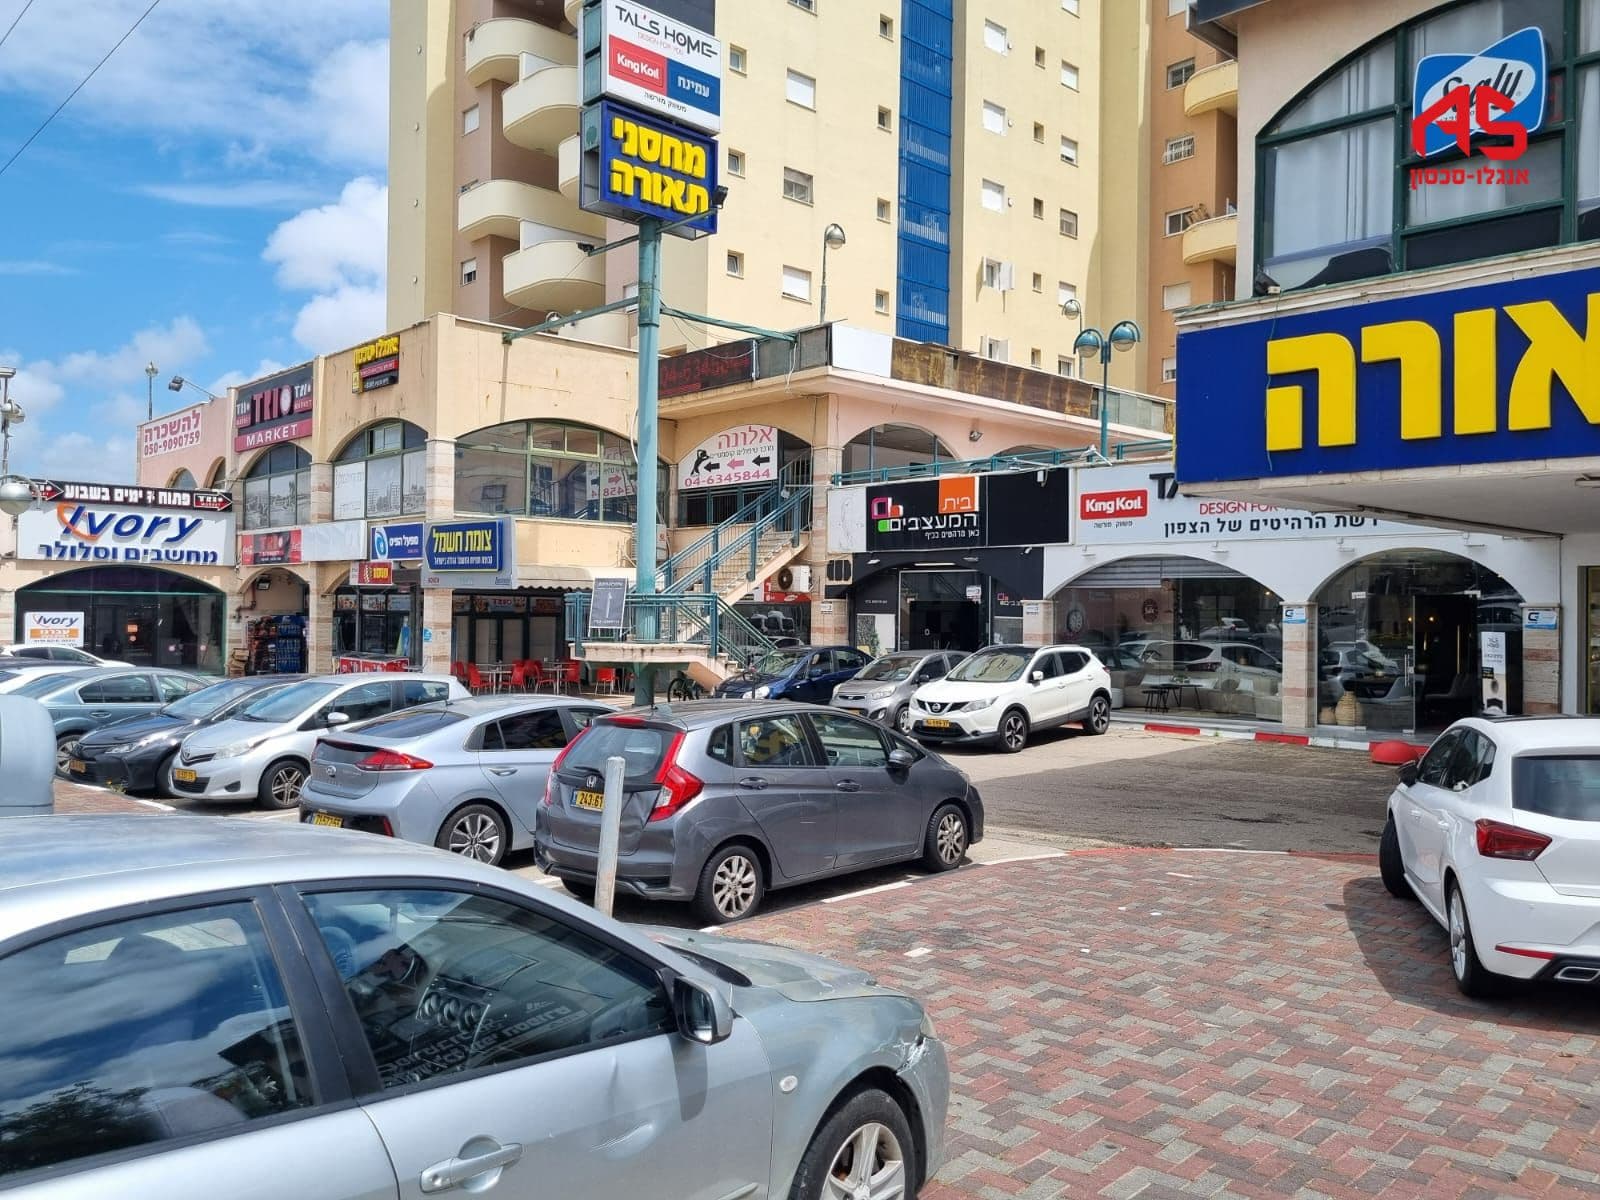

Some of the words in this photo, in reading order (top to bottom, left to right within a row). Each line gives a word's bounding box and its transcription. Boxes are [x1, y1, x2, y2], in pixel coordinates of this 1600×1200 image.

[615, 5, 660, 36] TAL'S
[664, 25, 718, 58] HOME
[678, 75, 710, 98] עמינח
[612, 117, 706, 179] מחסני
[611, 158, 709, 215] תאורה
[253, 384, 292, 423] TRIO
[144, 409, 201, 443] להשכרה
[246, 423, 298, 447] MARKET
[144, 430, 200, 456] 050-9090759
[717, 425, 773, 450] אלונה
[684, 468, 771, 488] 04-6345844
[64, 485, 111, 501] בשבוע
[113, 487, 143, 503] ימים
[158, 491, 191, 506] פתוח
[941, 496, 973, 511] בית
[1199, 501, 1247, 516] DESIGN
[62, 505, 203, 544] Ivory
[889, 513, 978, 532] המעצבים
[1164, 521, 1210, 538] הצפון
[1216, 517, 1242, 533] של
[1249, 514, 1327, 532] הרהיטים
[39, 540, 118, 560] וסלולר
[389, 537, 403, 547] הפיס
[402, 535, 419, 548] מפעל
[432, 527, 463, 553] חשמל
[465, 528, 492, 552] צומת
[124, 547, 218, 564] מחשבים
[36, 615, 80, 628] Ivory
